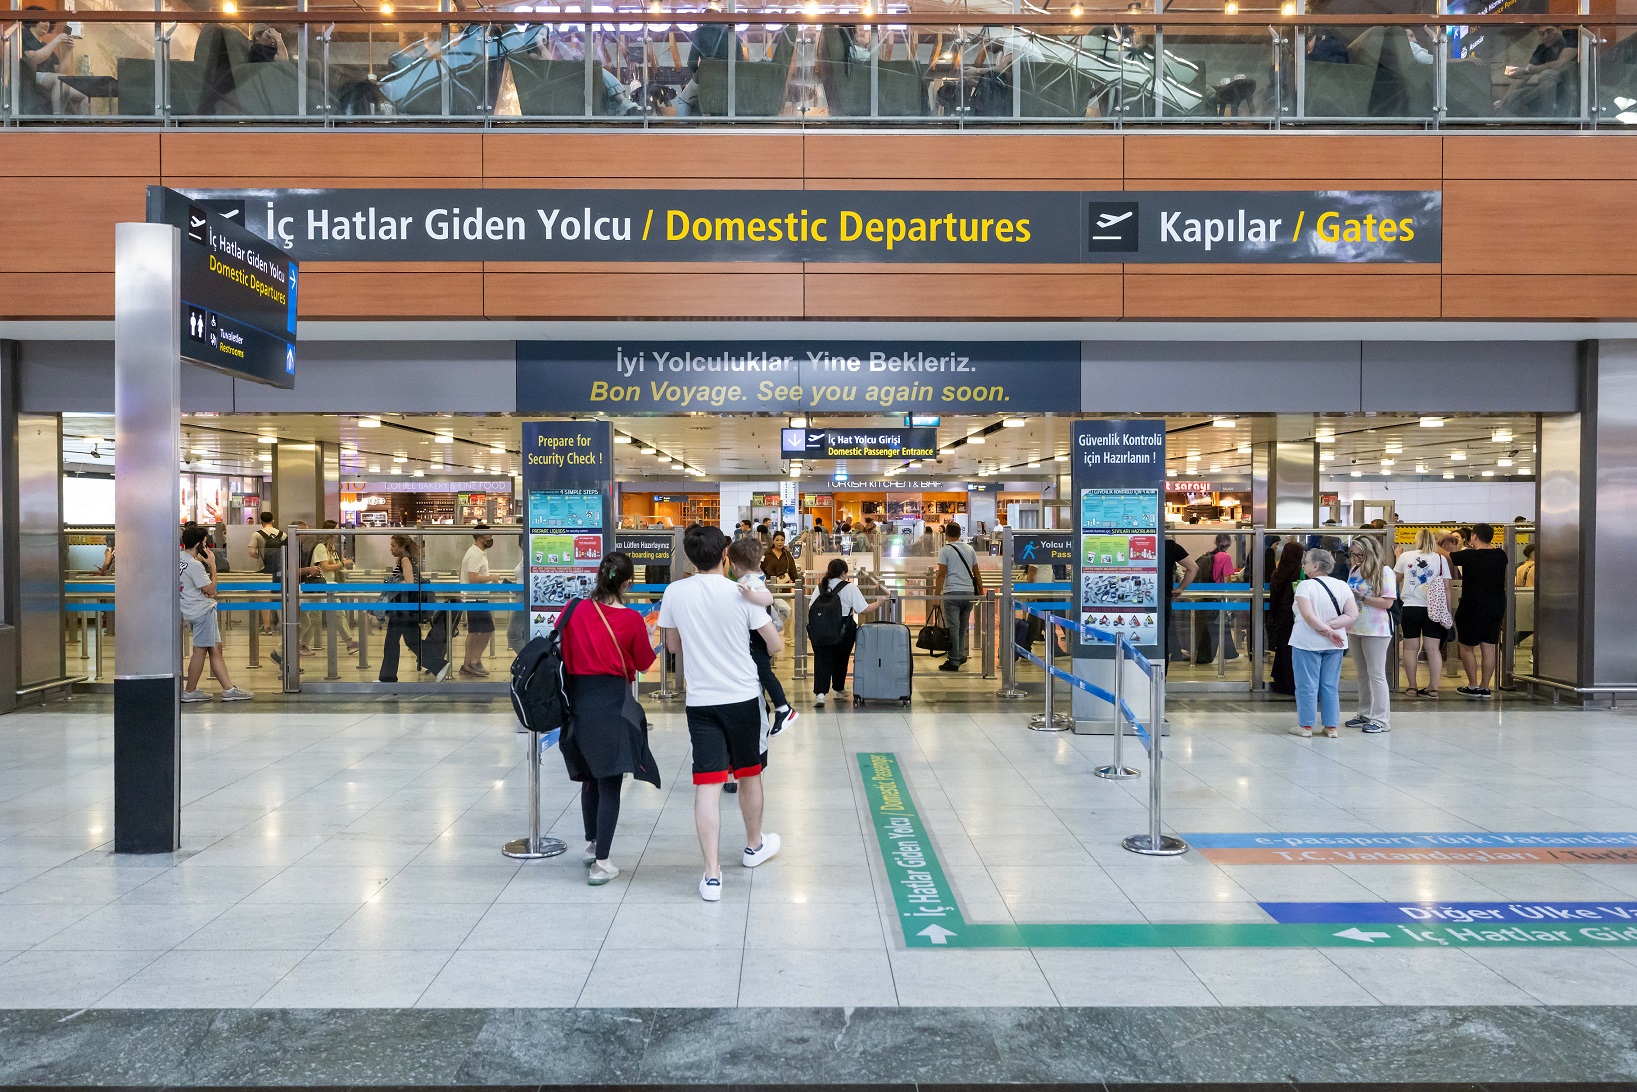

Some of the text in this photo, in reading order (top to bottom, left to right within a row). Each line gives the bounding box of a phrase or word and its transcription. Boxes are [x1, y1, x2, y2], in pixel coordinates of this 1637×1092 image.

[267, 201, 1031, 250] İç Hatlar Giden Yolcu / Domestic Departures
[1160, 209, 1415, 251] Kapılar / Gates
[209, 226, 285, 283] İç Hatlar Giden Yolcu
[209, 255, 286, 305] Domestic Departures
[220, 328, 244, 345] Tuvaletler
[220, 342, 245, 358] Restrooms
[616, 347, 976, 377] İyi Yolculuklar. Yine Bekleriz.
[590, 381, 1010, 406] Bon Voyage. See you again soon.
[538, 434, 591, 450] Prepare for
[828, 433, 901, 446] İç Hat Yolcu Girişi
[1078, 432, 1162, 446] Güvenlik Kontrolü
[528, 451, 603, 467] Security Check !
[828, 447, 934, 458] Domestic Passenger Entrance
[1084, 451, 1156, 467] için Hazırlanın !
[418, 482, 446, 490] BAKERY
[458, 482, 477, 490] FINE
[478, 482, 506, 490] FOOD
[623, 541, 640, 549] Lütfen
[1040, 540, 1064, 549] Yolcu
[631, 551, 655, 560] boarding
[655, 551, 670, 559] cards
[1051, 550, 1072, 558] Pass
[869, 754, 895, 781] Passenger
[874, 780, 906, 811] Domestic
[884, 817, 916, 840] Yolcu
[1254, 835, 1419, 847] e-pasaport
[1416, 834, 1494, 844] Türk
[892, 840, 927, 868] Giden
[1271, 851, 1335, 861] T.C.
[1331, 850, 1541, 862] Vatandaşları
[900, 870, 942, 903] Hatlar
[1398, 906, 1505, 923] Diğer
[1508, 904, 1603, 919] Ülke
[1396, 924, 1450, 946] İç
[1444, 926, 1573, 942] Hatlar
